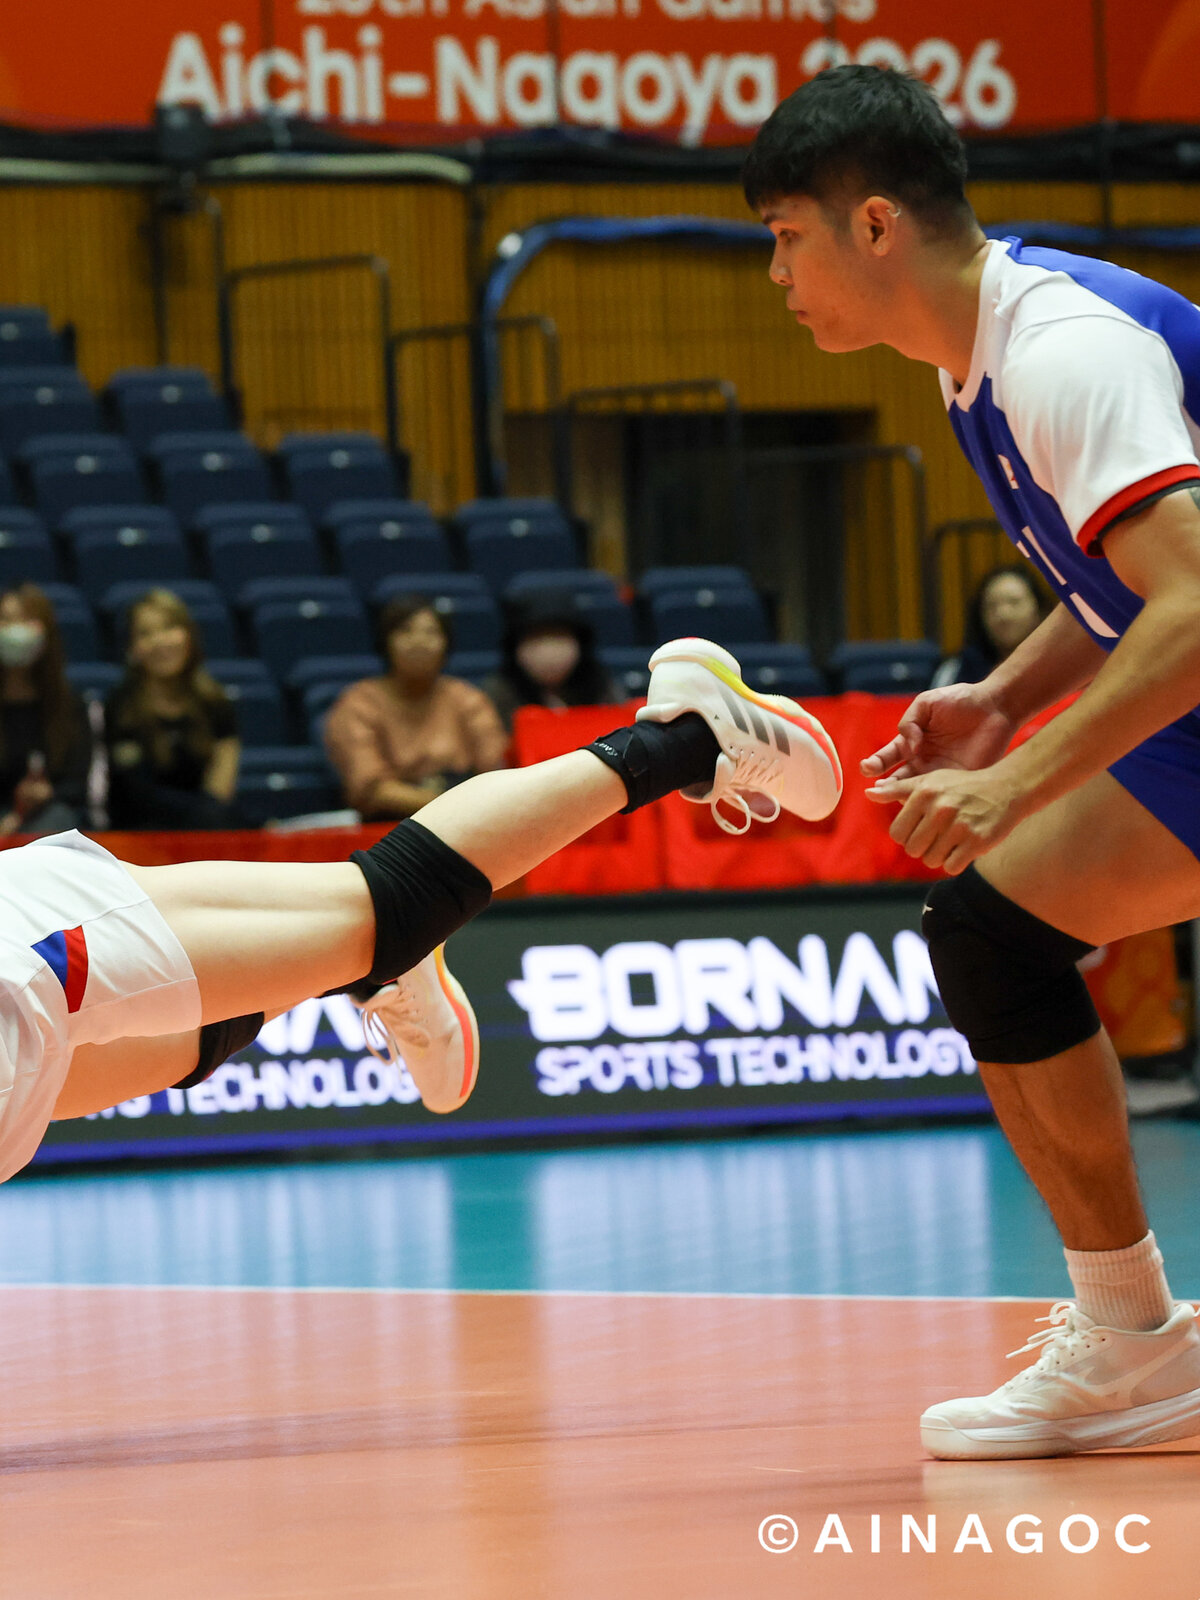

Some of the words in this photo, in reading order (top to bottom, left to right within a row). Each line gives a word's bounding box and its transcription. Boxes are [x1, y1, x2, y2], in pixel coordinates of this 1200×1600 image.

[156, 22, 778, 147] Aichi-Nagoya
[166, 1056, 422, 1116] ECHNOLOG
[535, 1040, 702, 1096] SPORTS
